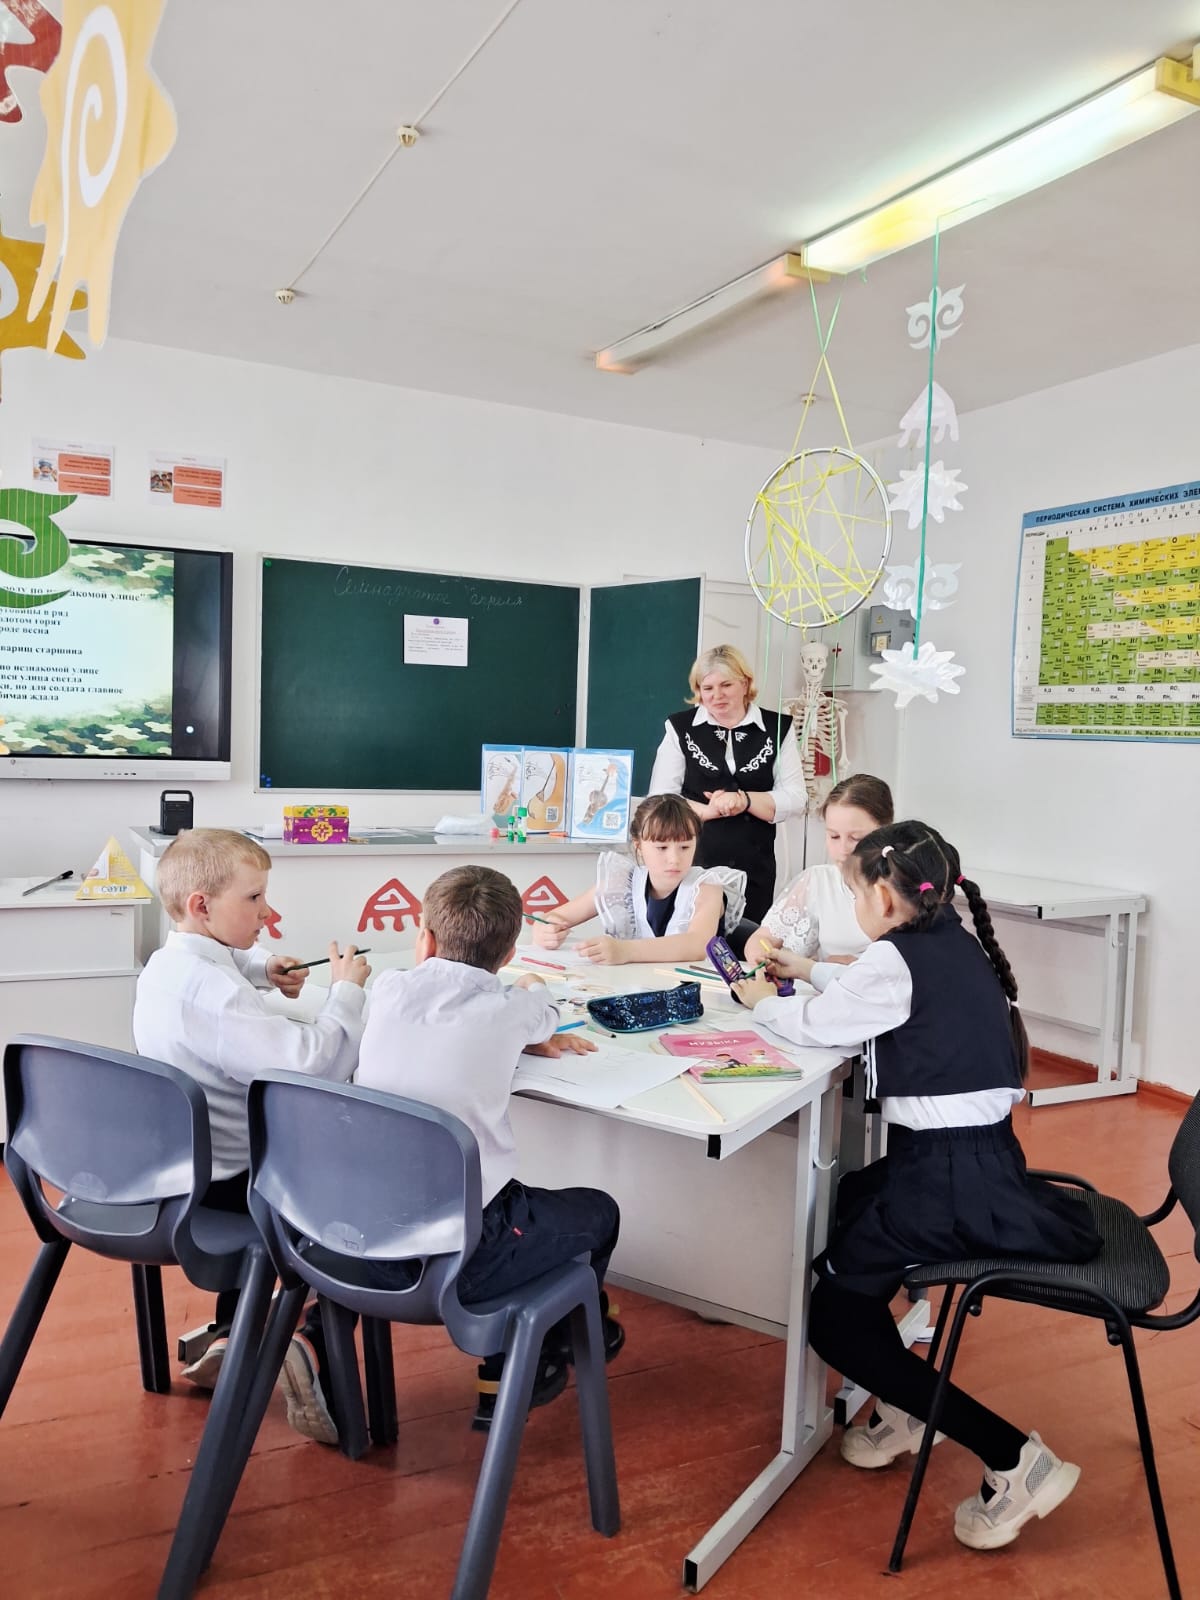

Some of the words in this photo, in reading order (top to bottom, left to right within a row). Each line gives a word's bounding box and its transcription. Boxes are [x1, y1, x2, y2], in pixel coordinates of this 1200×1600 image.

[1035, 507, 1090, 523] ПЕРИОДИЧЕСКАЯ
[1093, 501, 1126, 513] СИСТЕМА
[1129, 493, 1179, 507] ХИМИЧЕСКИХ
[1183, 487, 1200, 498] ЭЛЕ
[35, 647, 83, 655] старшина
[14, 665, 69, 673] незнакомой
[72, 667, 100, 675] улице
[49, 685, 85, 693] солдата
[688, 1039, 741, 1047] МУЗЫКА
